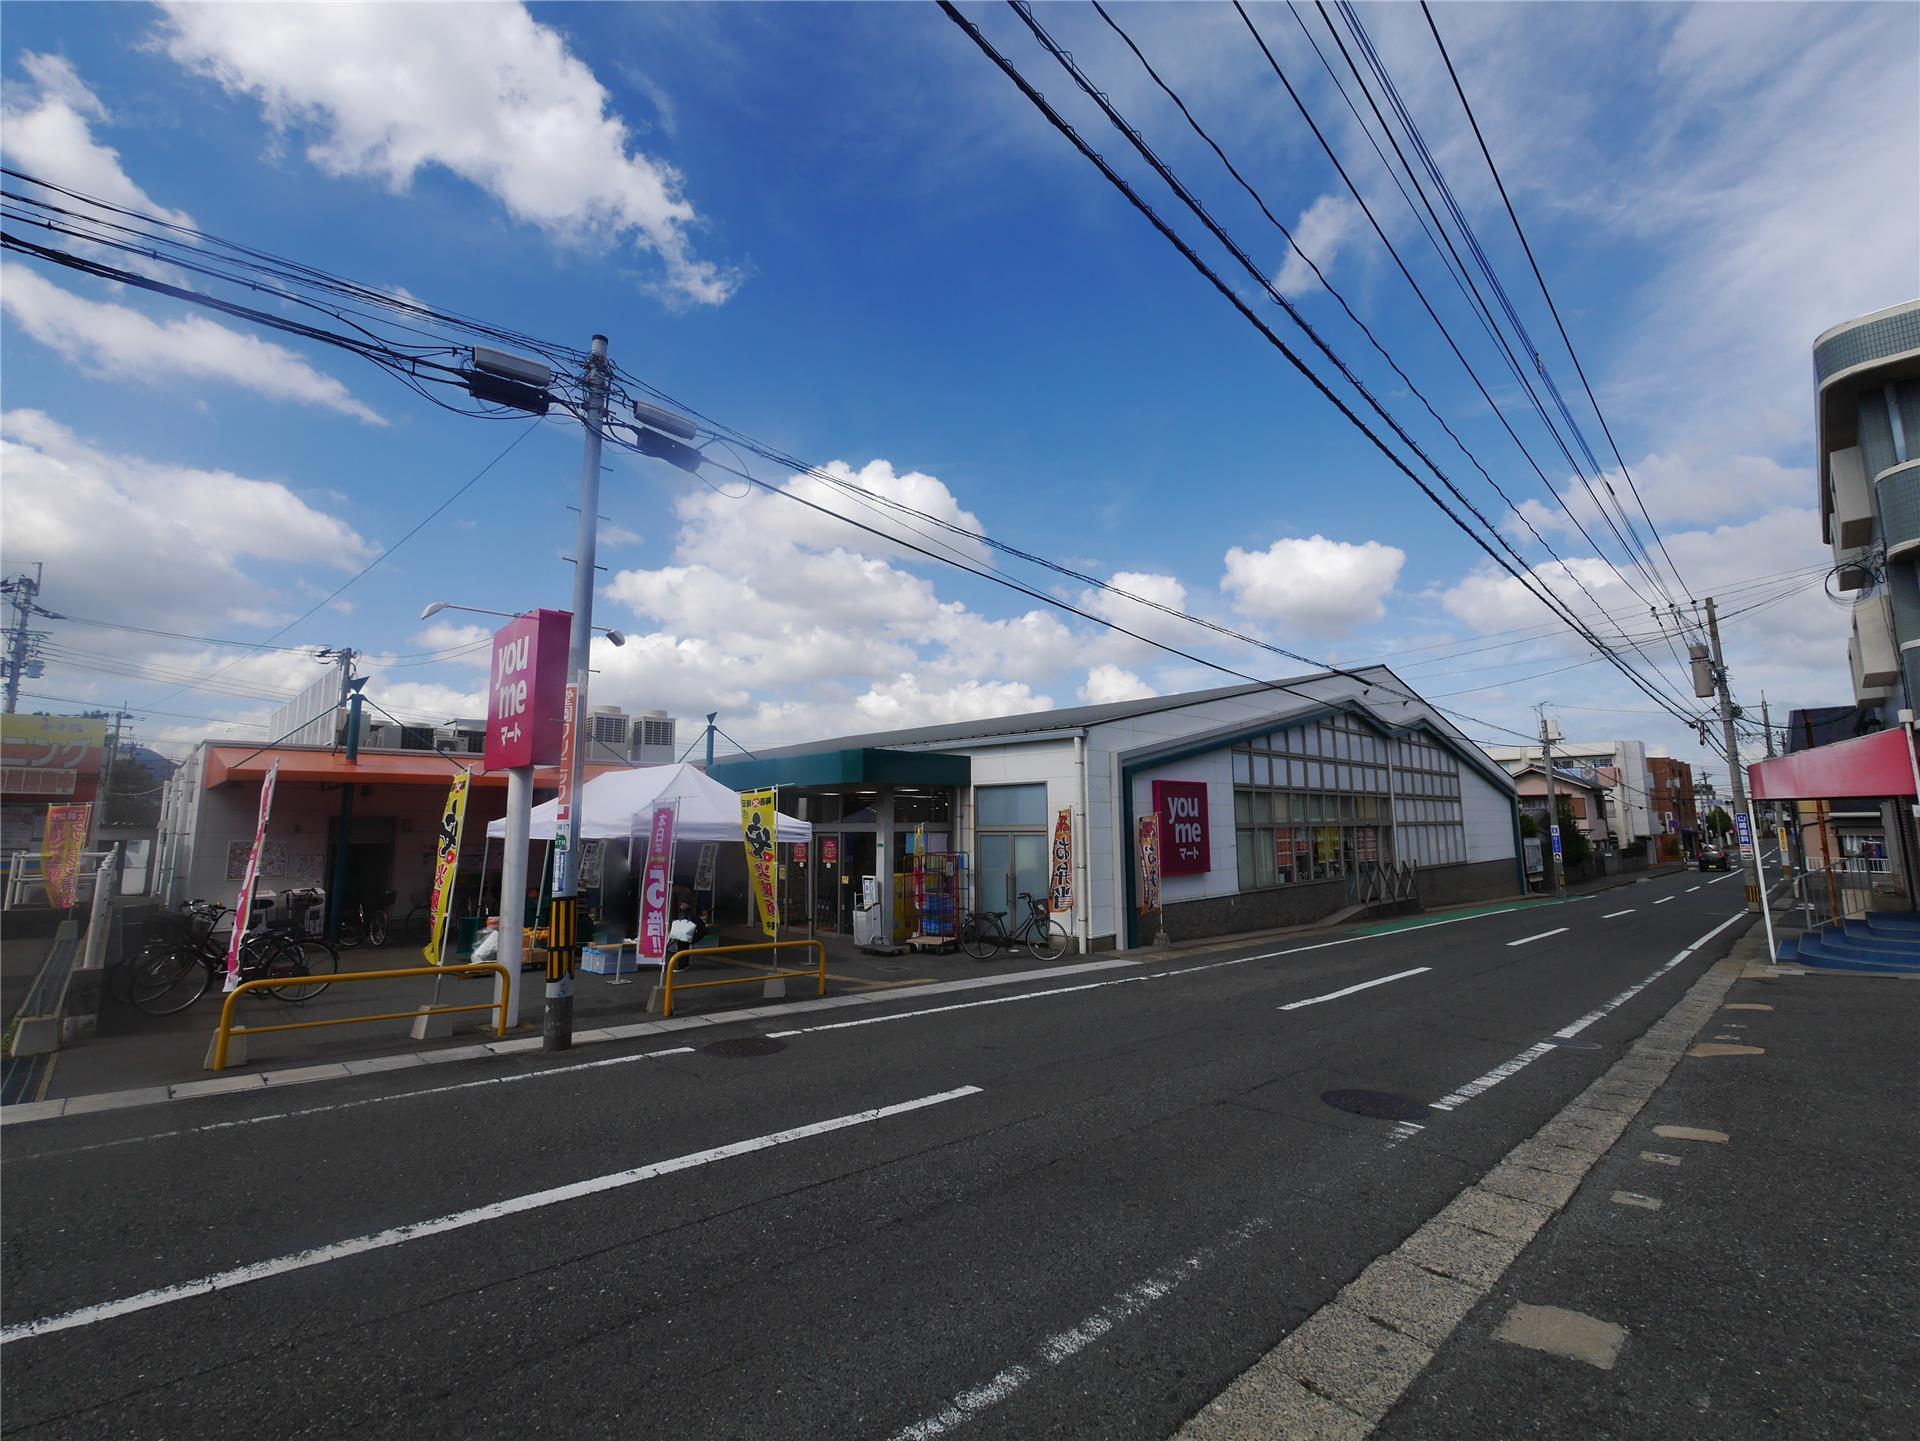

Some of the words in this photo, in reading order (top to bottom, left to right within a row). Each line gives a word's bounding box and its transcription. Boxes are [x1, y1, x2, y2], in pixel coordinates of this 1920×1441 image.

[495, 635, 529, 689] you
[498, 679, 527, 720] me
[500, 721, 522, 747] マート
[1168, 796, 1199, 823] you
[1175, 820, 1202, 844] me
[1179, 847, 1200, 861] マート
